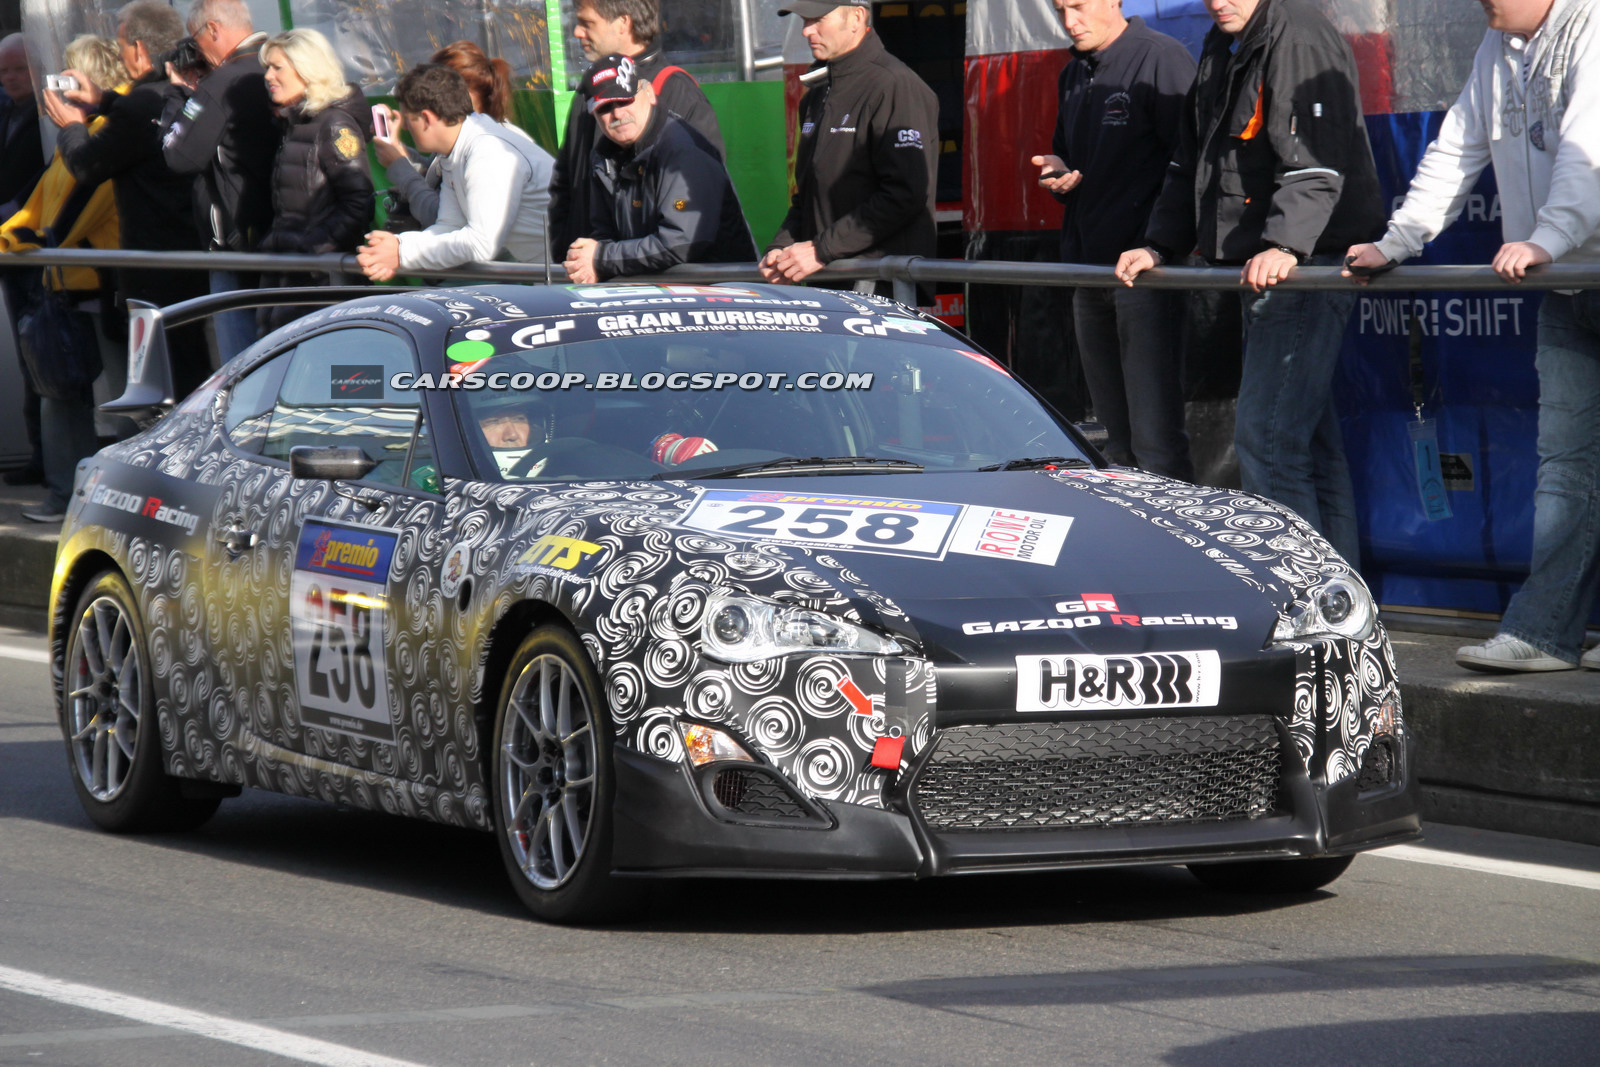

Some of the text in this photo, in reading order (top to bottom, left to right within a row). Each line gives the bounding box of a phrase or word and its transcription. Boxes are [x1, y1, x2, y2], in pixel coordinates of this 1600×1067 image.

[569, 296, 822, 309] GAZOO Racing
[1358, 297, 1524, 337] POWER SHIFT
[597, 310, 682, 332] GRAN
[600, 323, 823, 338] THE REAL DRIVING SIMULATOR
[92, 484, 200, 536] GAZOO Racing
[778, 495, 923, 511] premio
[727, 504, 920, 545] 258
[977, 510, 1030, 557] ROWE
[1016, 517, 1047, 560] MOTOR OIL
[322, 537, 380, 569] premio
[514, 534, 604, 571] ATS
[760, 537, 854, 550] www.premio.de
[1055, 599, 1118, 614] GR
[962, 613, 1239, 636] GAZOO Racing
[308, 590, 377, 711] 258
[1039, 656, 1146, 708] H&R
